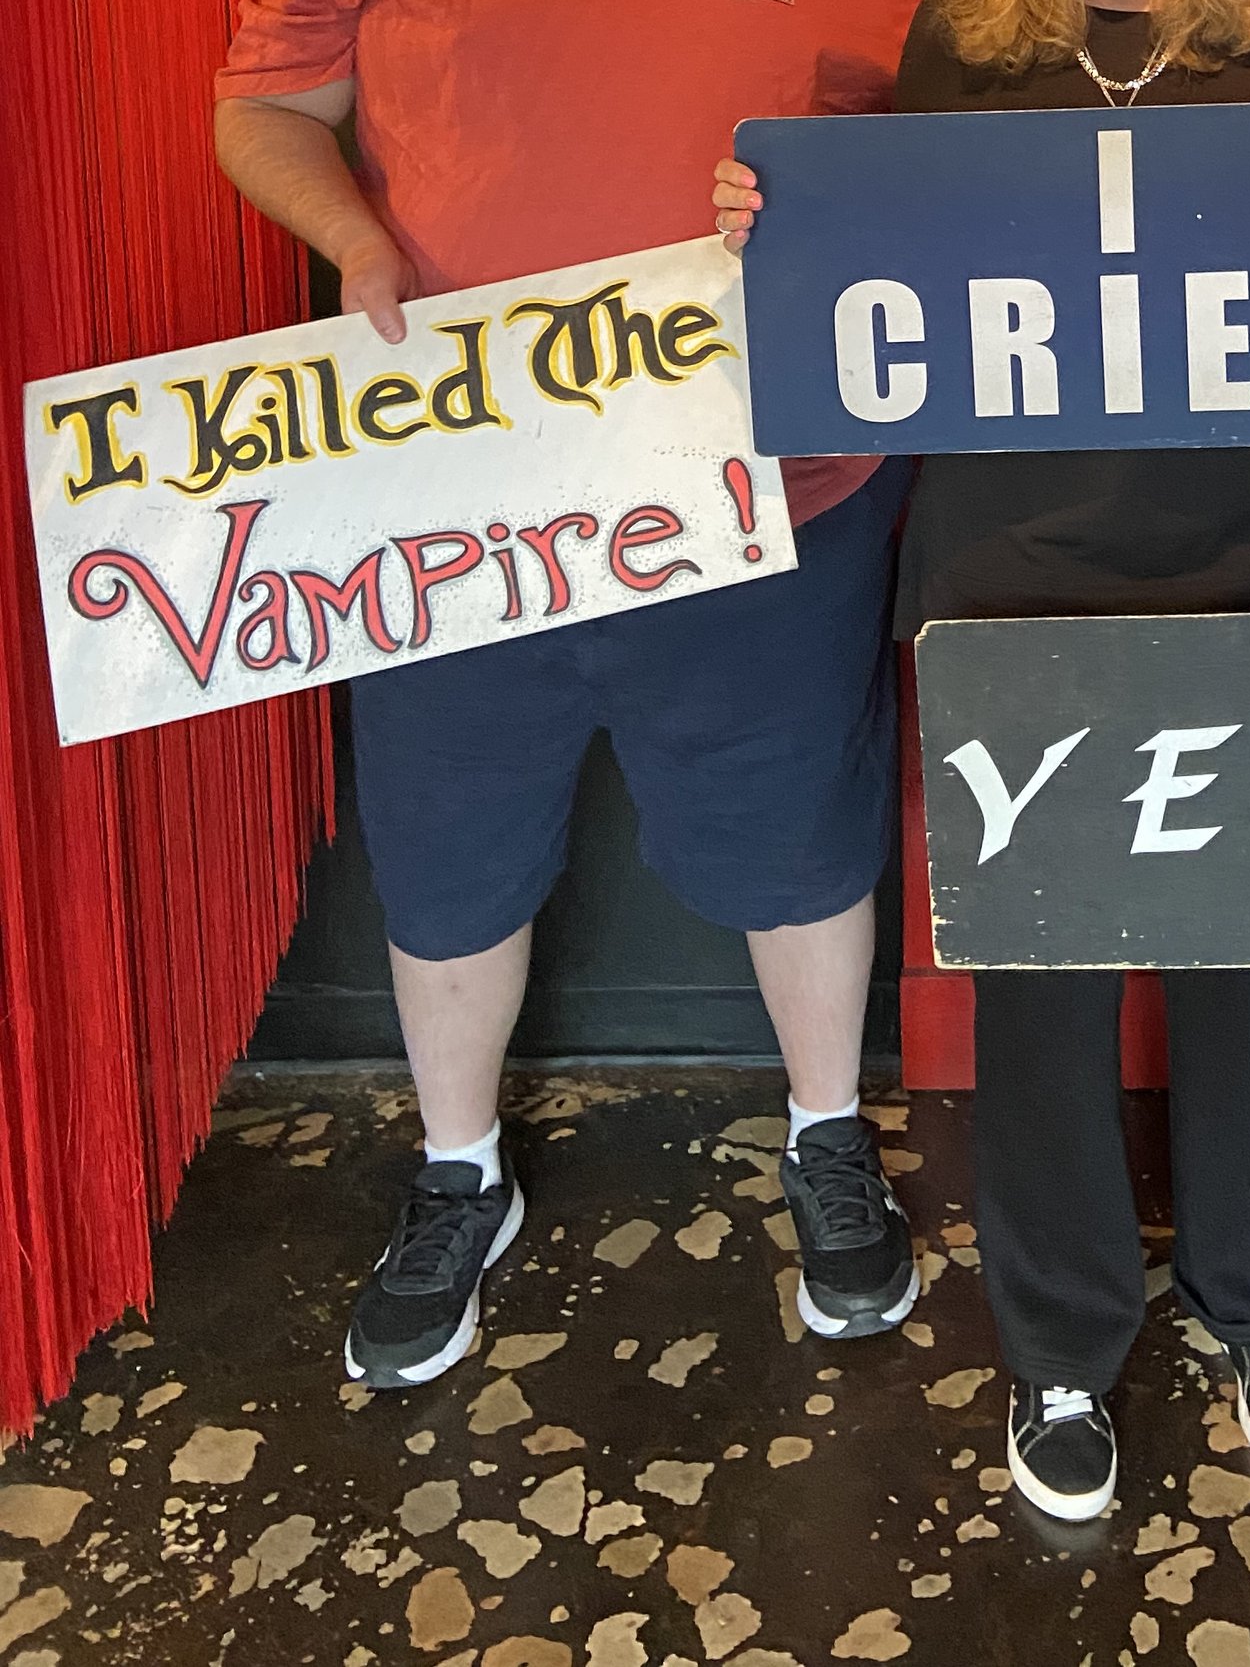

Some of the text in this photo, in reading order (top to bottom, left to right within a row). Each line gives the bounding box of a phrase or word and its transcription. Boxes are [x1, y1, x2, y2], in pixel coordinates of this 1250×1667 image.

[1097, 129, 1135, 253] I
[45, 280, 740, 504] I Killed The
